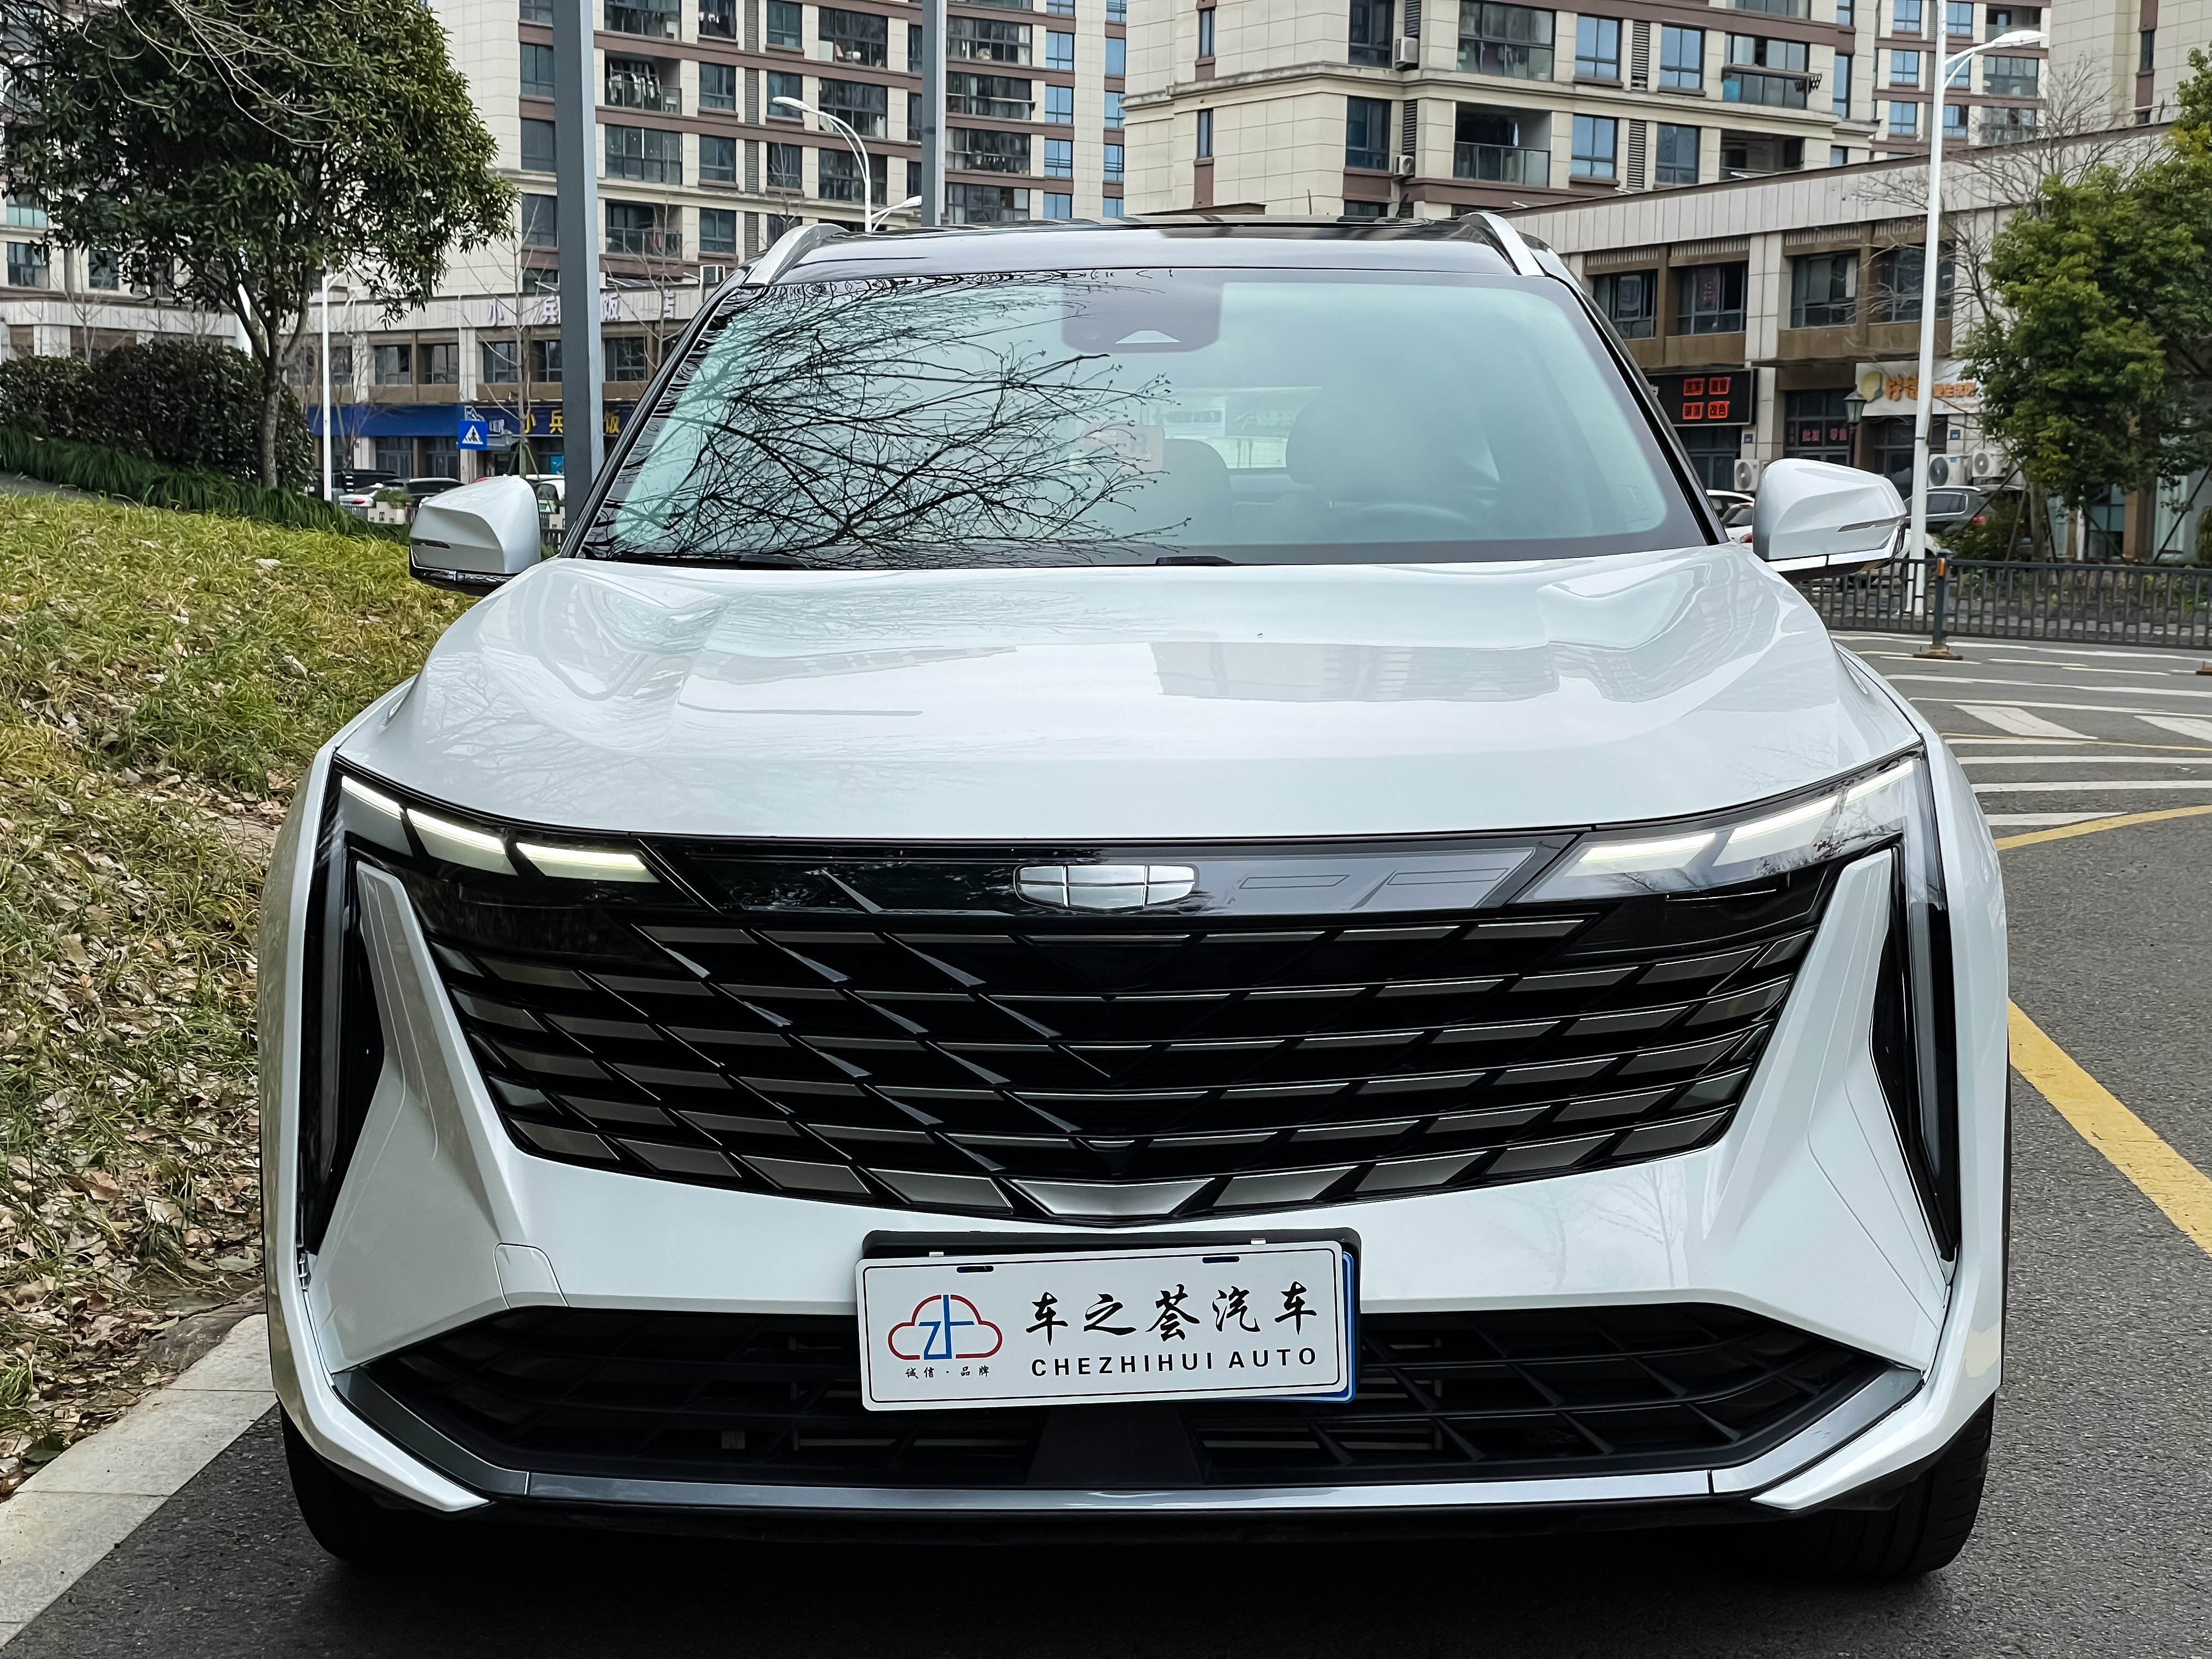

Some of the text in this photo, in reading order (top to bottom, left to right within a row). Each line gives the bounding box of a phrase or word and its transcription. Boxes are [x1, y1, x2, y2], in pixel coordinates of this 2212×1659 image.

[1025, 1281, 1317, 1346] 车之荟汽车
[1031, 1347, 1316, 1376] CHEZHIHUI AUTO
